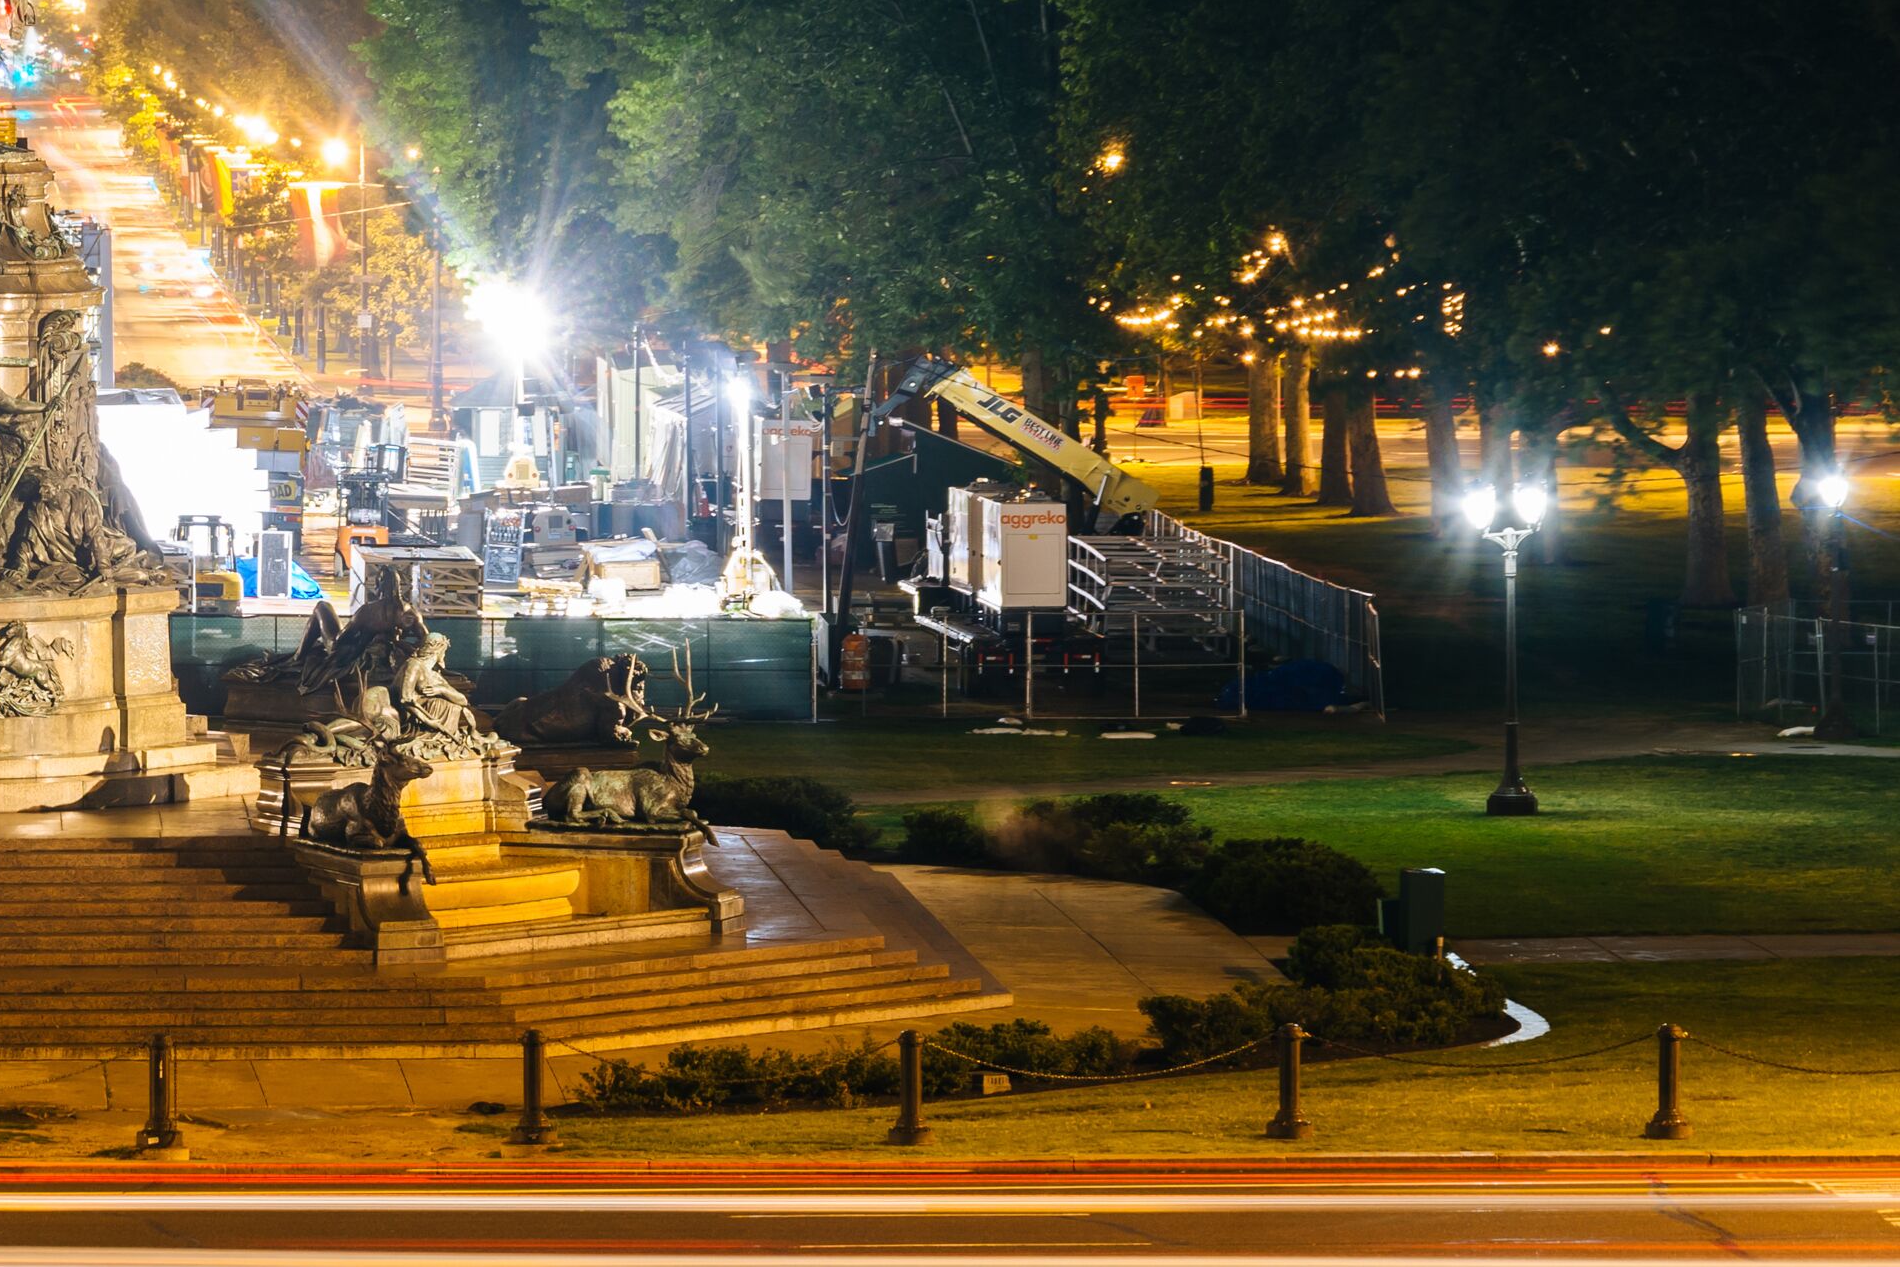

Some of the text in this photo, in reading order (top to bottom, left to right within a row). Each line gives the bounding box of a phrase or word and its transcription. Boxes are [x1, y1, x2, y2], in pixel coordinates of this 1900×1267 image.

[976, 395, 1024, 424] JLG
[762, 425, 811, 437] aggeko
[270, 484, 292, 499] OAD
[1000, 510, 1067, 529] aggreko
